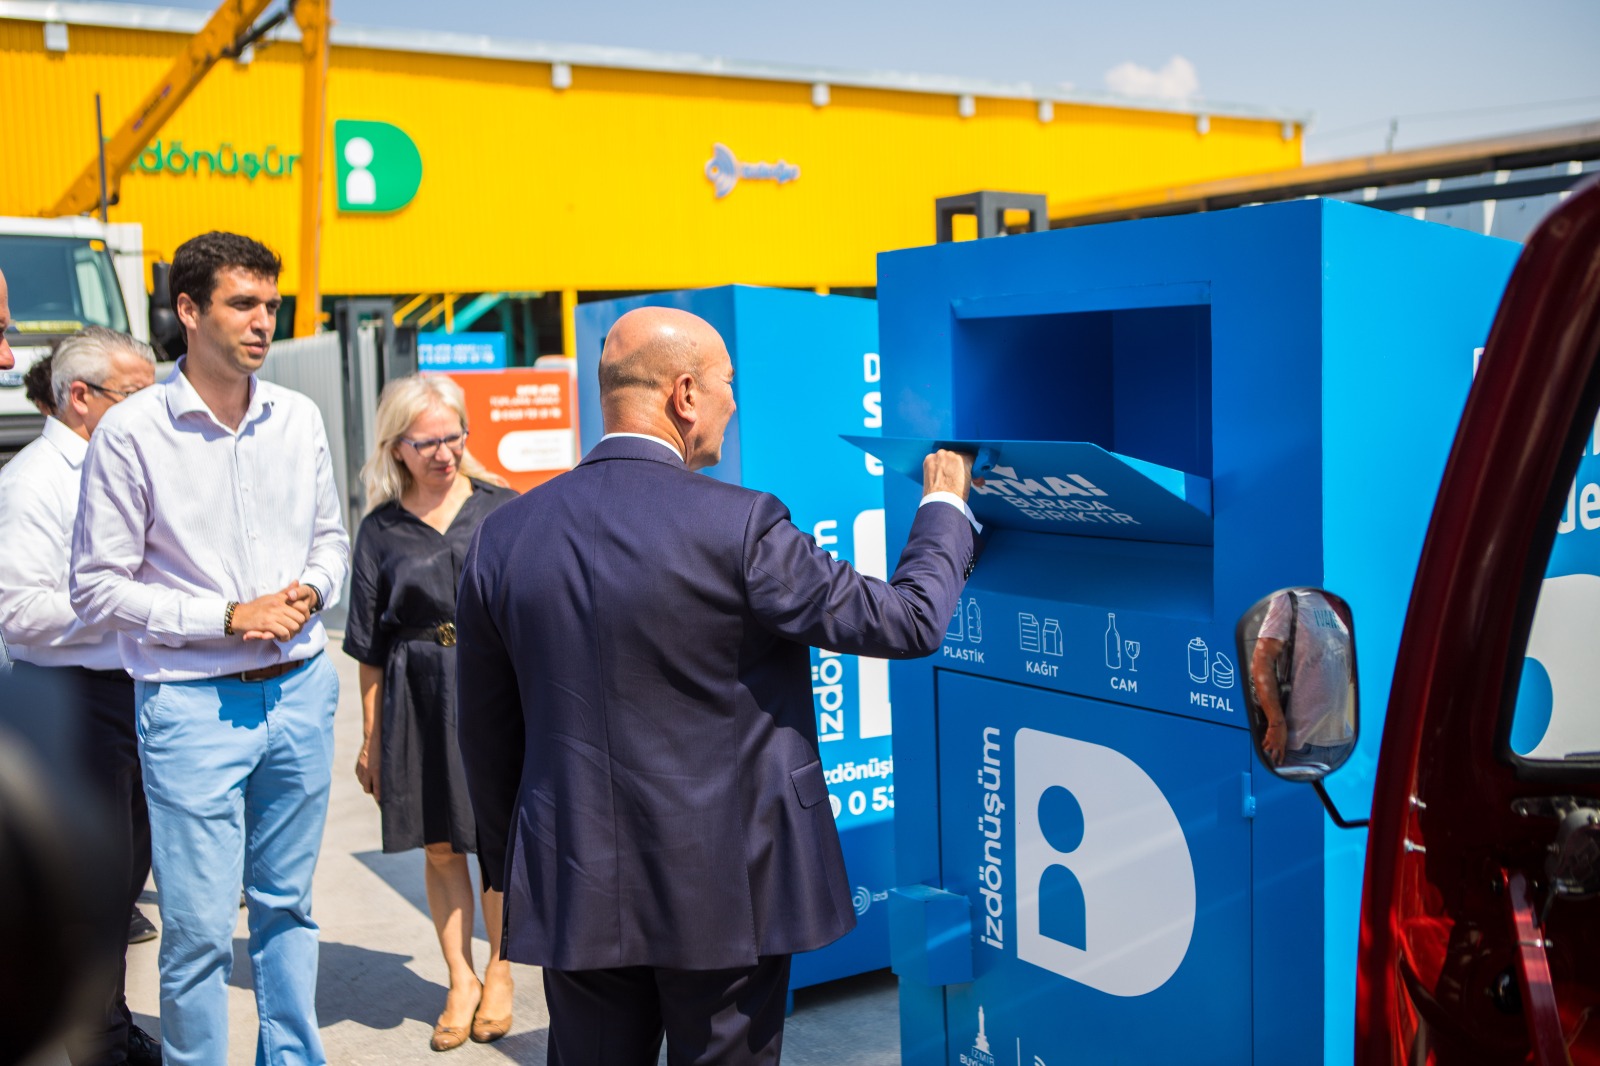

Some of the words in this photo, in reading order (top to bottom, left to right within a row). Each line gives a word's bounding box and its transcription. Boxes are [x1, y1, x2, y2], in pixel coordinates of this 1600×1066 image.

[131, 139, 302, 180] dönüşü
[1001, 496, 1116, 512] BURADA
[943, 645, 985, 663] PLASTİK
[1026, 660, 1059, 677] KAĞIT
[1110, 676, 1138, 693] CAM
[1190, 691, 1234, 713] METAL
[977, 726, 1005, 950] izdönüşüm
